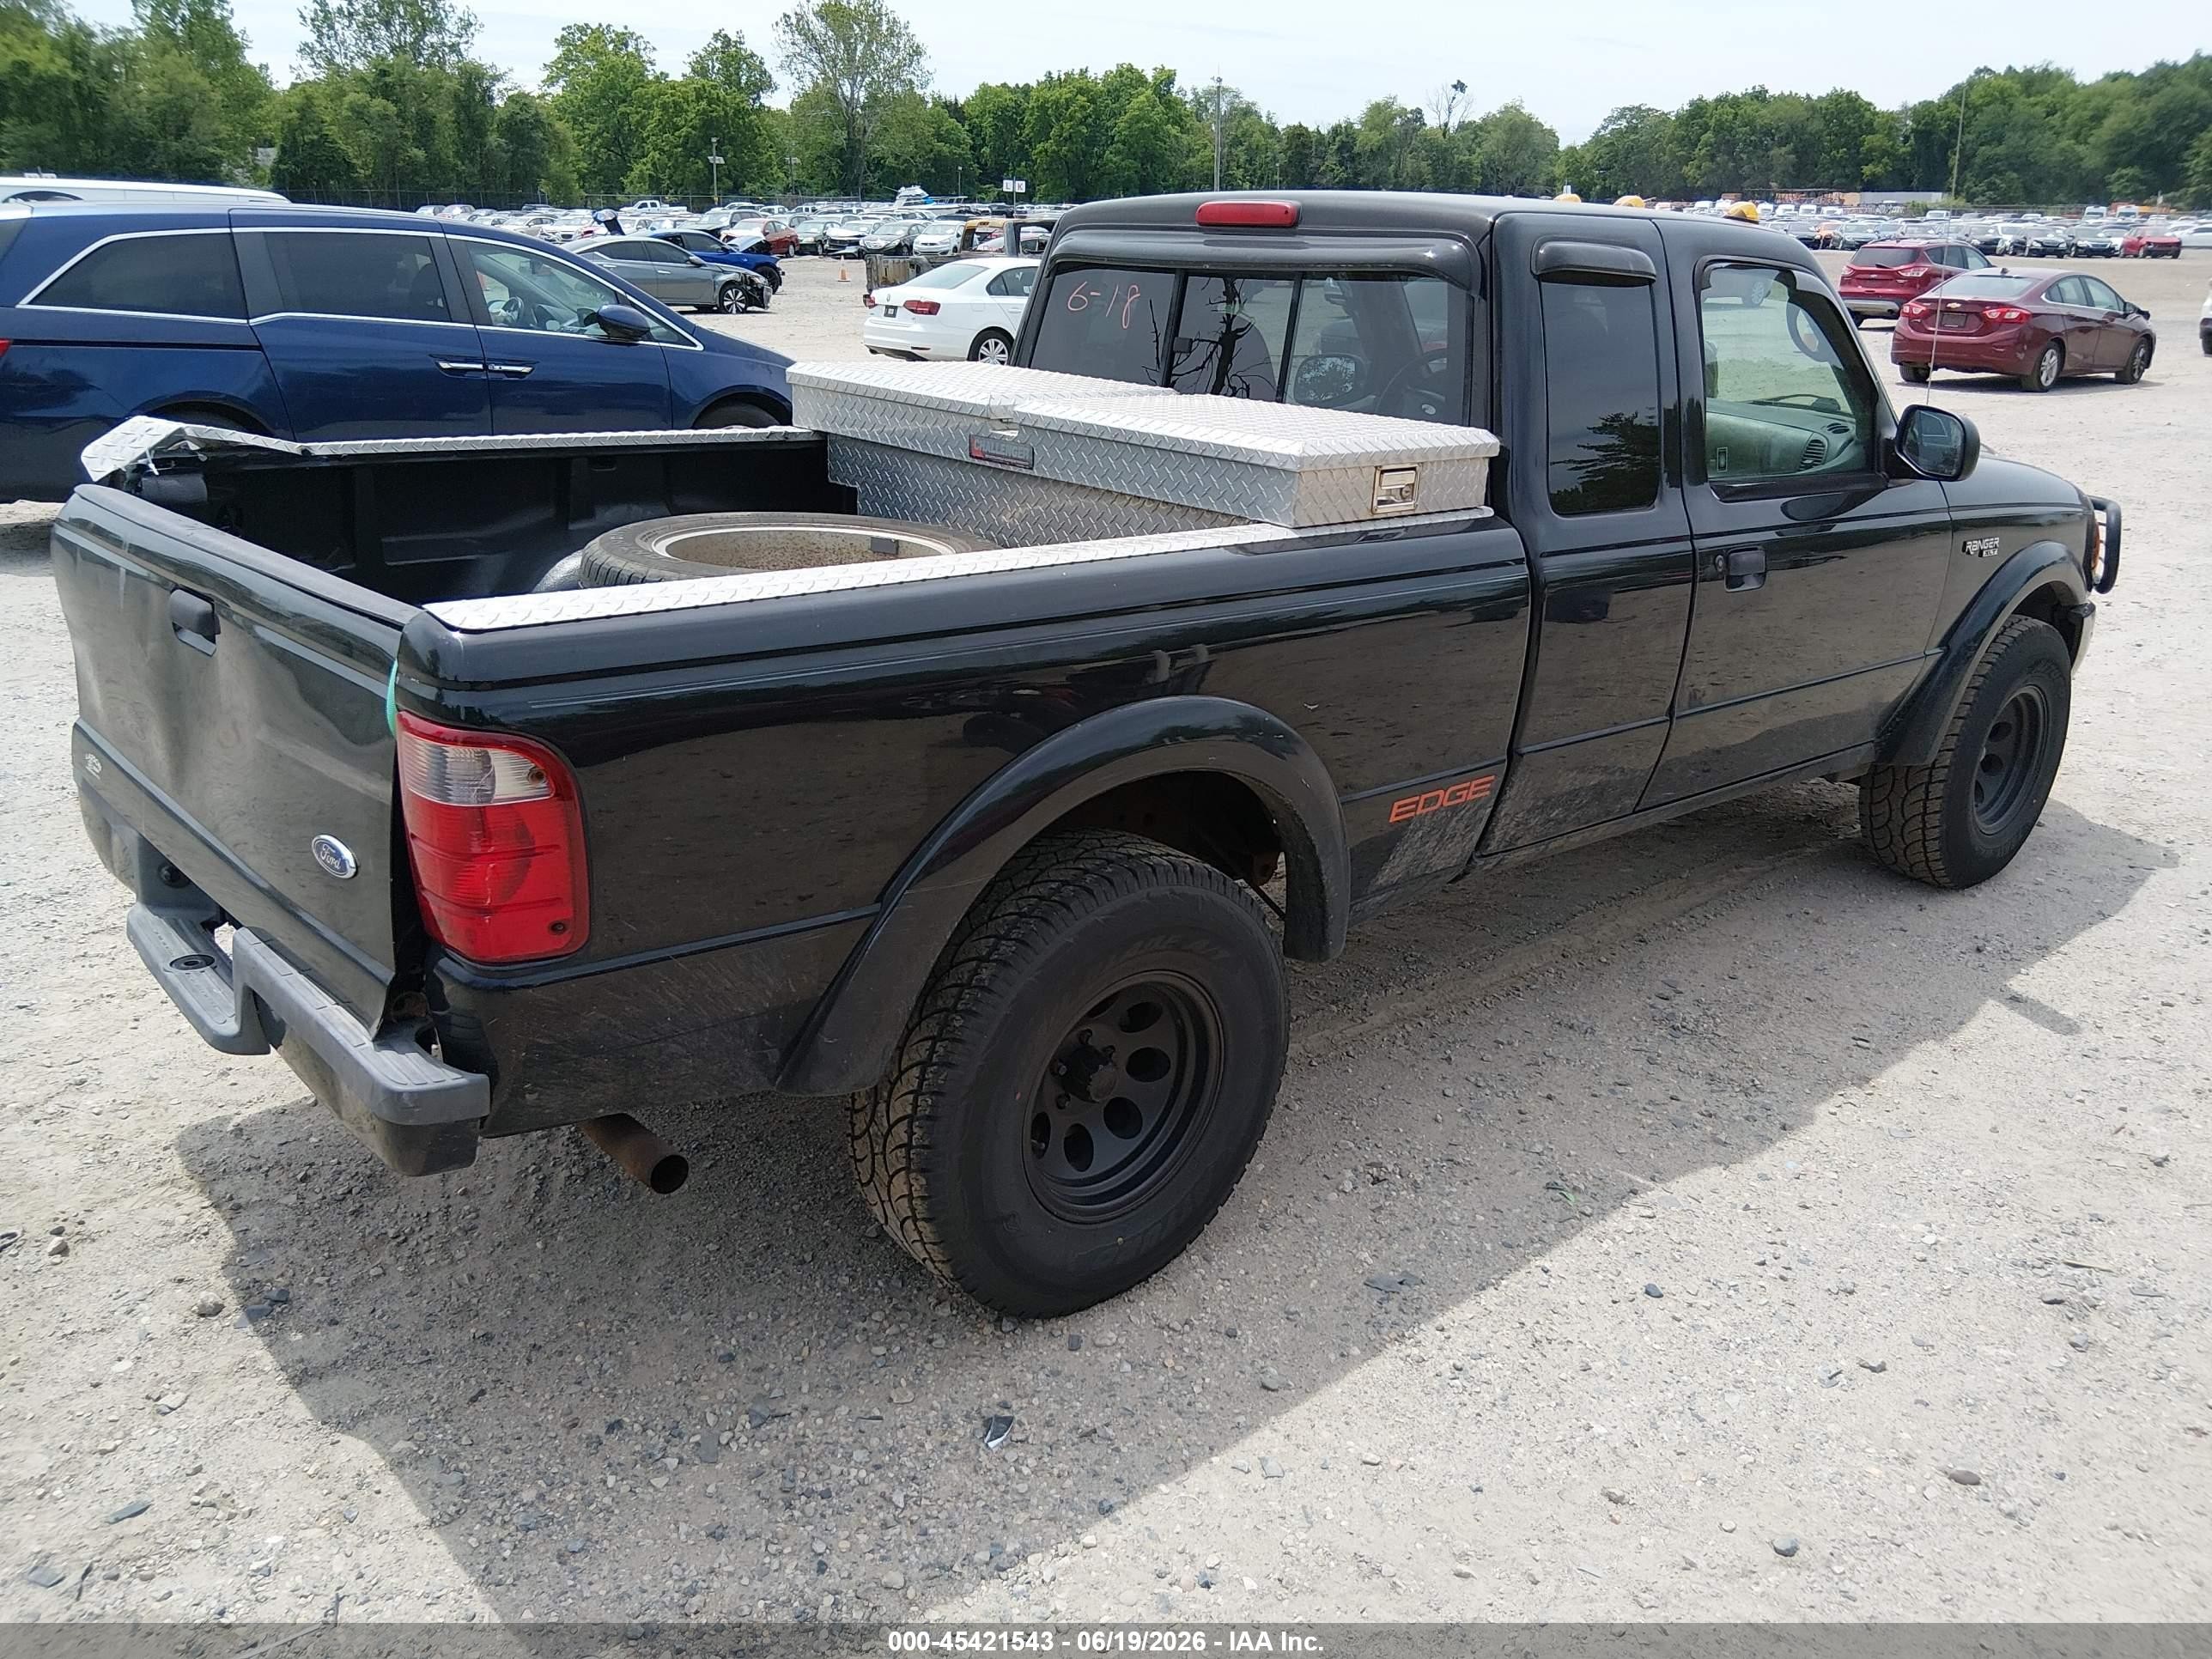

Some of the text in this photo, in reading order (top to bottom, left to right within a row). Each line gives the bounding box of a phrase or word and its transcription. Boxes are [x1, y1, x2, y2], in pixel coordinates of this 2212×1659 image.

[1067, 281, 1140, 329] 6-18
[973, 438, 1030, 461] CHALLENGER
[1964, 537, 2000, 555] RANGER
[1389, 775, 1496, 823] EDGE
[319, 843, 342, 870] Ford
